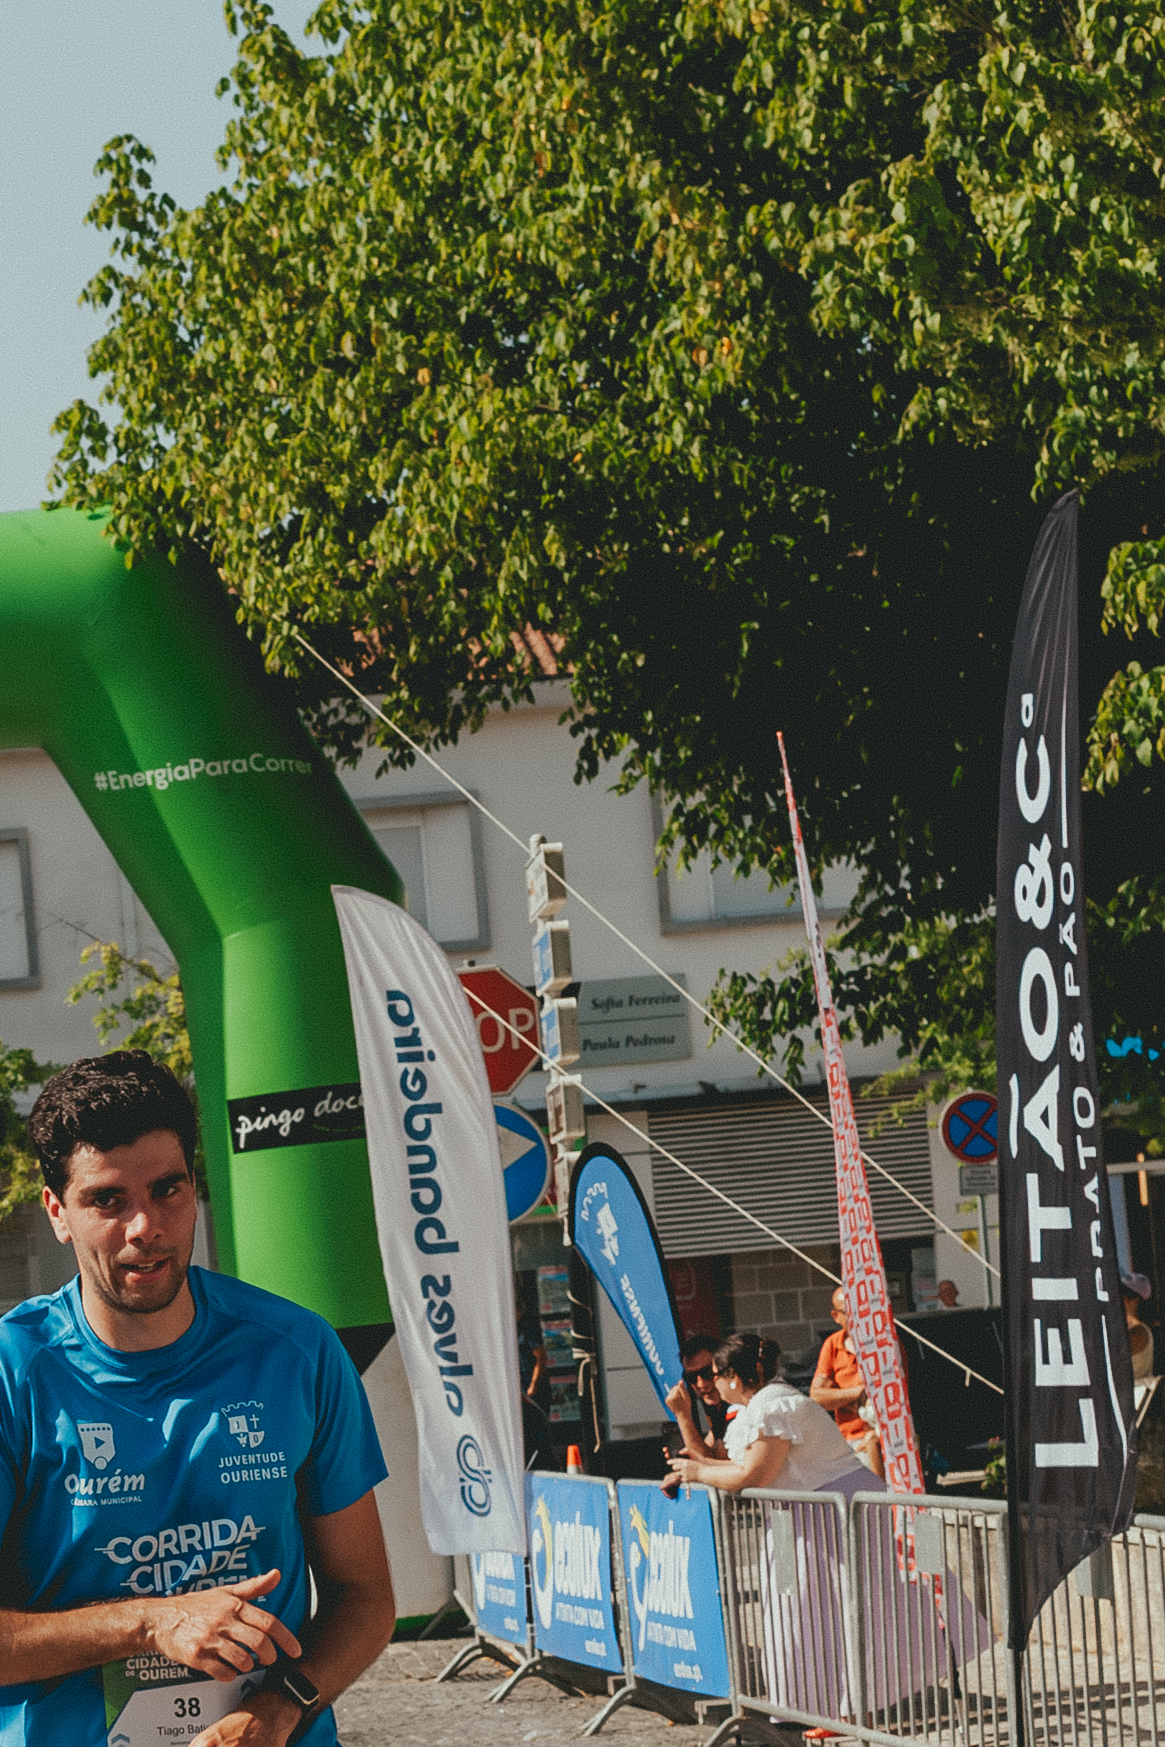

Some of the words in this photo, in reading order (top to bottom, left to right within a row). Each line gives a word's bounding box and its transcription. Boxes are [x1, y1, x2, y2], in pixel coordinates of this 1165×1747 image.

[94, 753, 312, 791] #EnergiaParaCorrer
[1059, 862, 1081, 997] PÃO
[475, 1007, 536, 1053] OP
[1069, 1022, 1086, 1062] &
[235, 1106, 305, 1149] pingo
[1073, 1086, 1109, 1302] PRATO
[218, 1452, 286, 1468] JUVENTUDE
[220, 1466, 288, 1484] OURIENSE
[64, 1468, 146, 1495] Ourém
[100, 1495, 142, 1506] MUNICIPAL
[96, 1515, 264, 1564] CORRIDA
[122, 1545, 250, 1596] CIDADE
[139, 1667, 189, 1681] OUREM
[174, 1697, 201, 1718] 38
[157, 1727, 185, 1737] Tiago
